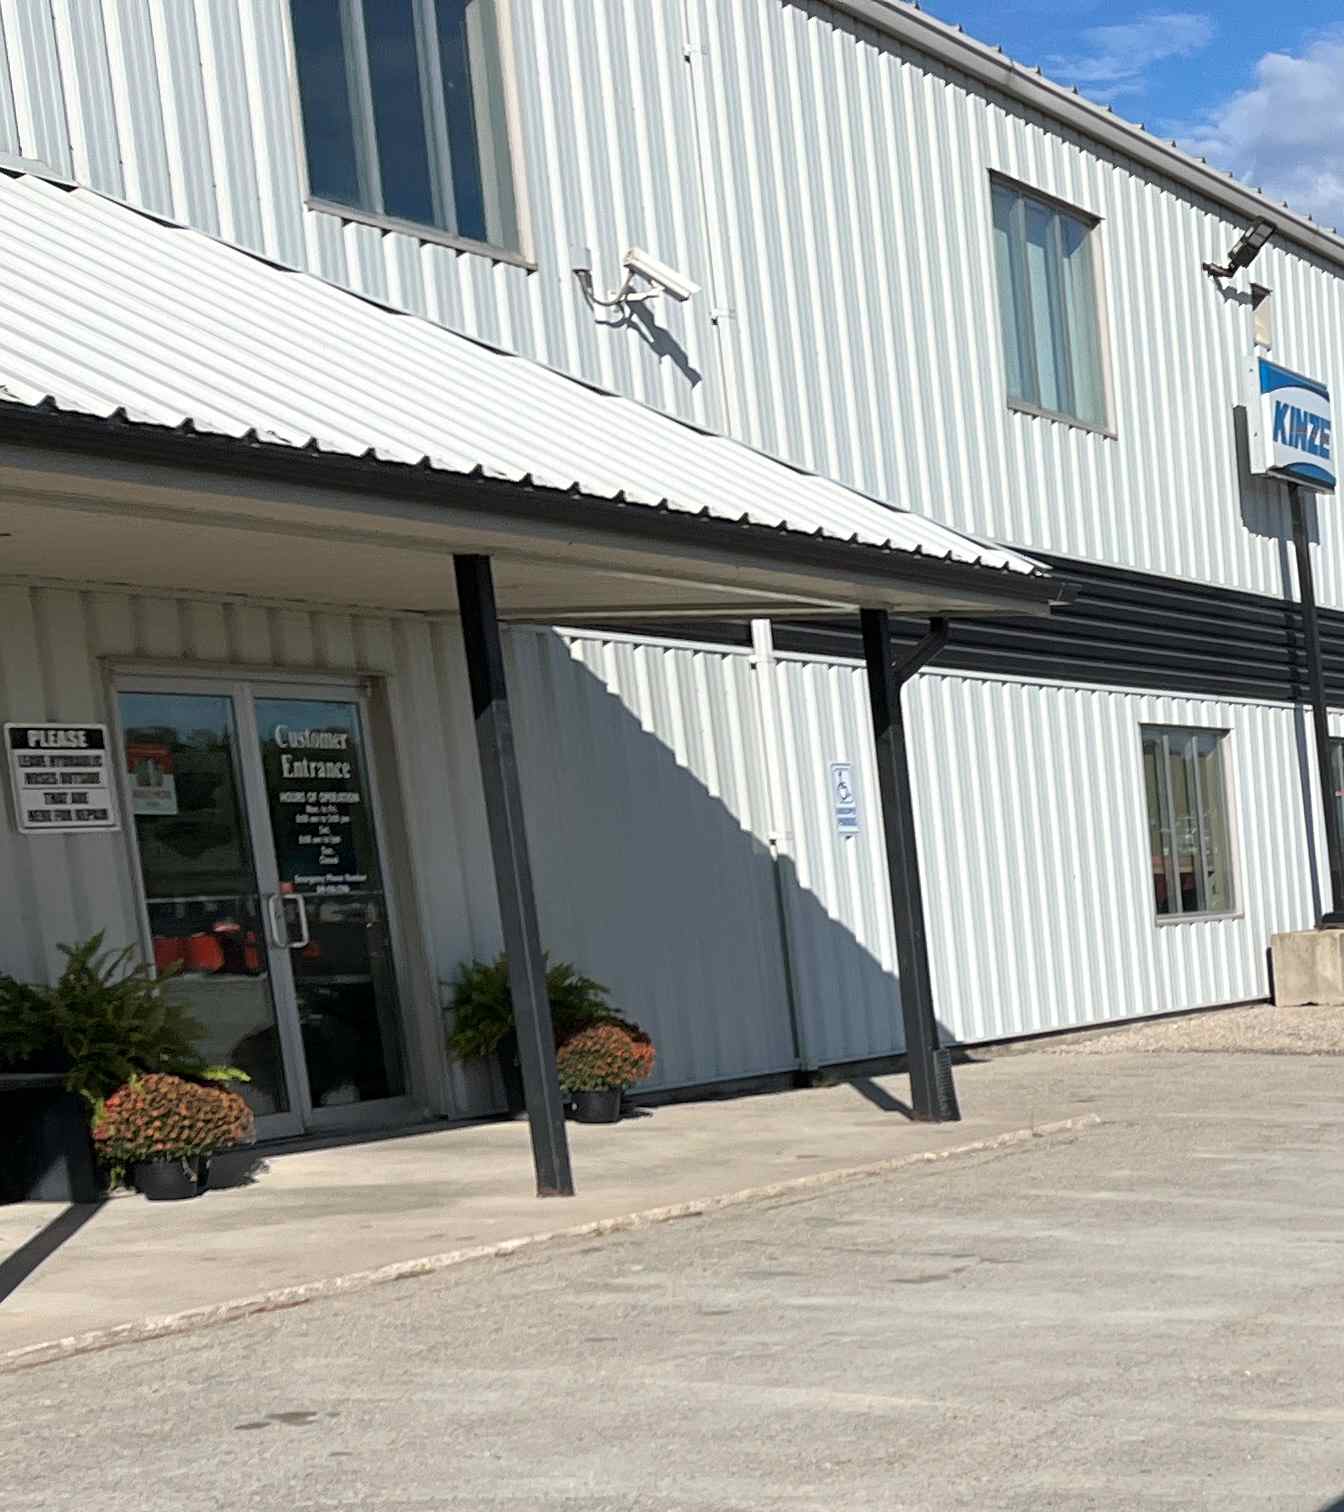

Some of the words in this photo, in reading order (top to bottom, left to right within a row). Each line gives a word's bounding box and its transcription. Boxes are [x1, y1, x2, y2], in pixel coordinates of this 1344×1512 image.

[1273, 400, 1331, 459] KINZE
[27, 730, 88, 747] PLEASE
[275, 724, 349, 750] Customer
[281, 754, 353, 778] Entrance
